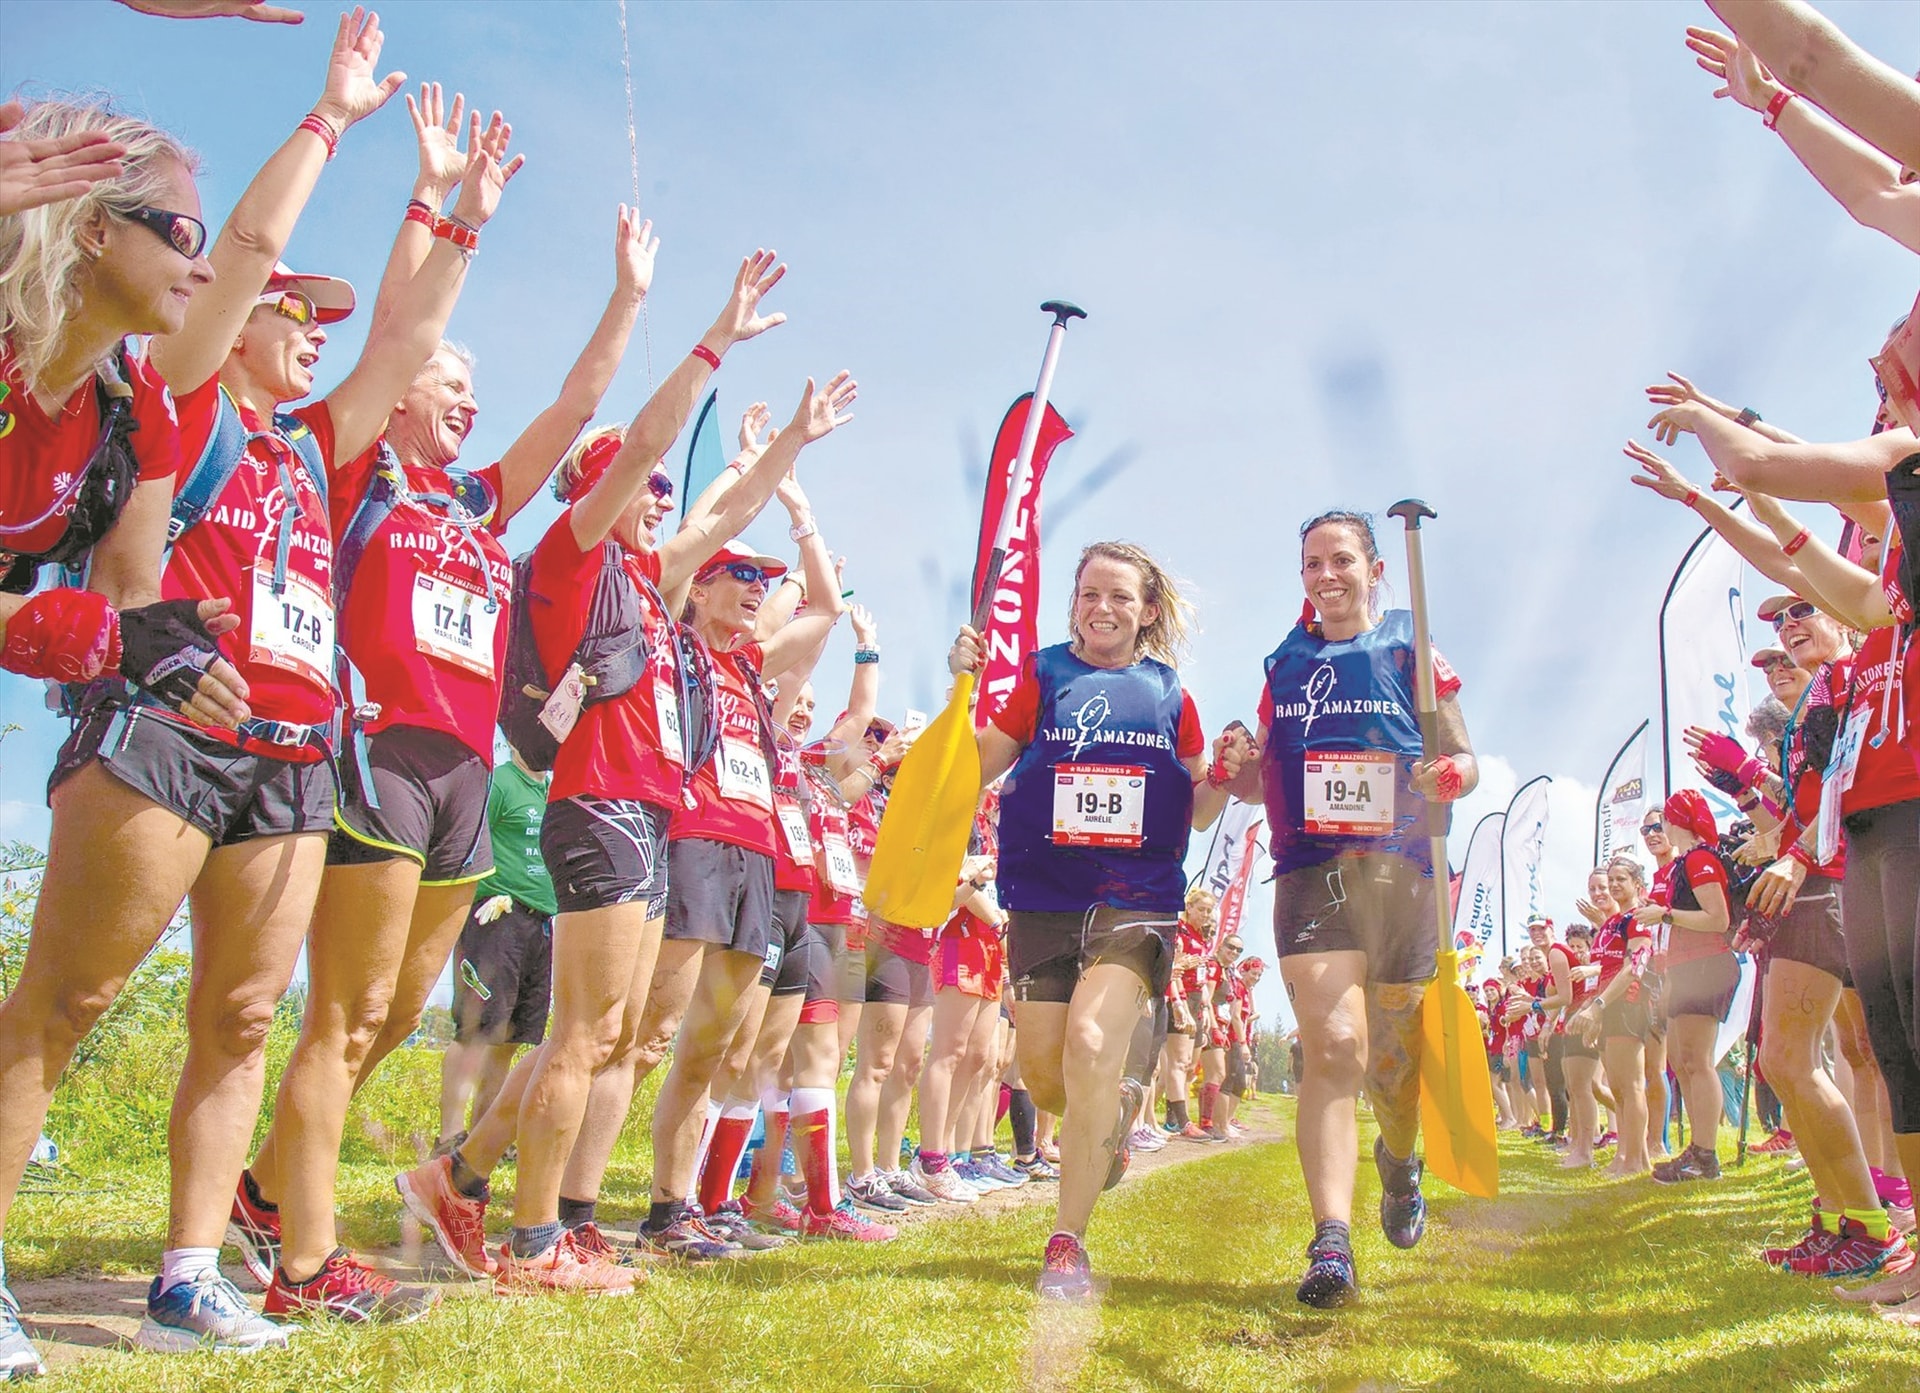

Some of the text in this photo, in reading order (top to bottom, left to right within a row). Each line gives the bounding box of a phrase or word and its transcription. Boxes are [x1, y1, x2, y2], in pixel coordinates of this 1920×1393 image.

[390, 532, 438, 552] RAID
[281, 602, 322, 645] 17-B
[434, 603, 472, 640] 17-A
[291, 634, 316, 654] CAROLE
[664, 708, 678, 733] 62
[1276, 699, 1401, 719] RAID AMAZONES
[730, 712, 758, 732] AMAZ
[1093, 729, 1171, 751] AMAZONES
[729, 758, 762, 784] 62-A
[1324, 780, 1372, 803] 19-A
[1075, 792, 1123, 815] 19-B
[1329, 803, 1366, 812] AMANDINE
[1469, 882, 1485, 929] europ
